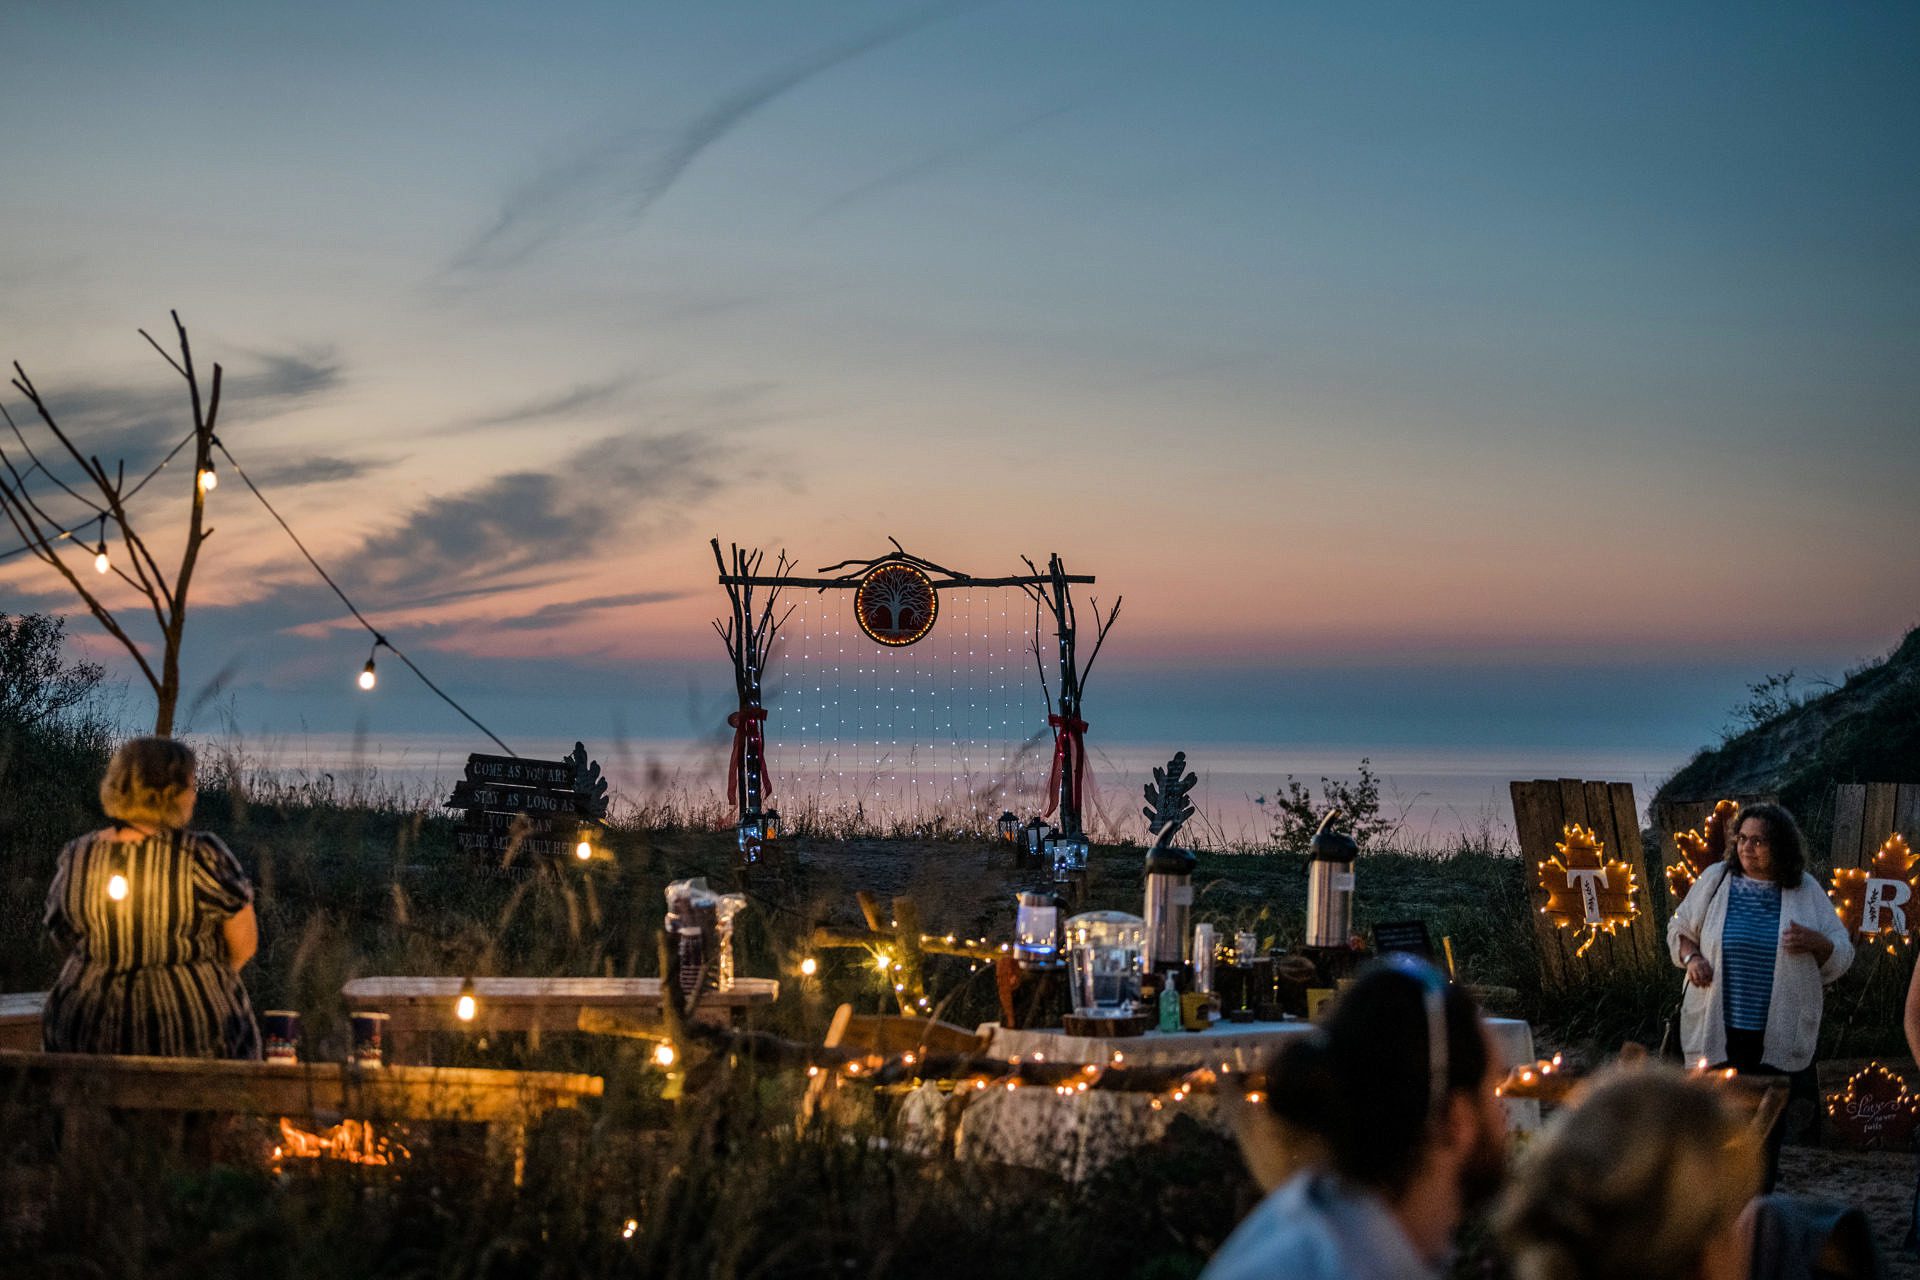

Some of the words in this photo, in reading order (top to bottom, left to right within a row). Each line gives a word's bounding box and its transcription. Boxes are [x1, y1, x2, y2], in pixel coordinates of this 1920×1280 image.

[473, 762, 503, 777] COME
[507, 765, 521, 778] AS
[525, 766, 544, 780] YOU
[548, 768, 568, 783] ARE
[473, 790, 500, 805] STAY
[506, 792, 520, 806] AS
[526, 794, 557, 810] LONG
[560, 798, 576, 812] AS
[488, 814, 513, 829] YOU
[516, 839, 552, 854] AMILY
[553, 841, 577, 855] HER
[1566, 869, 1610, 925] T
[1858, 878, 1912, 936] R
